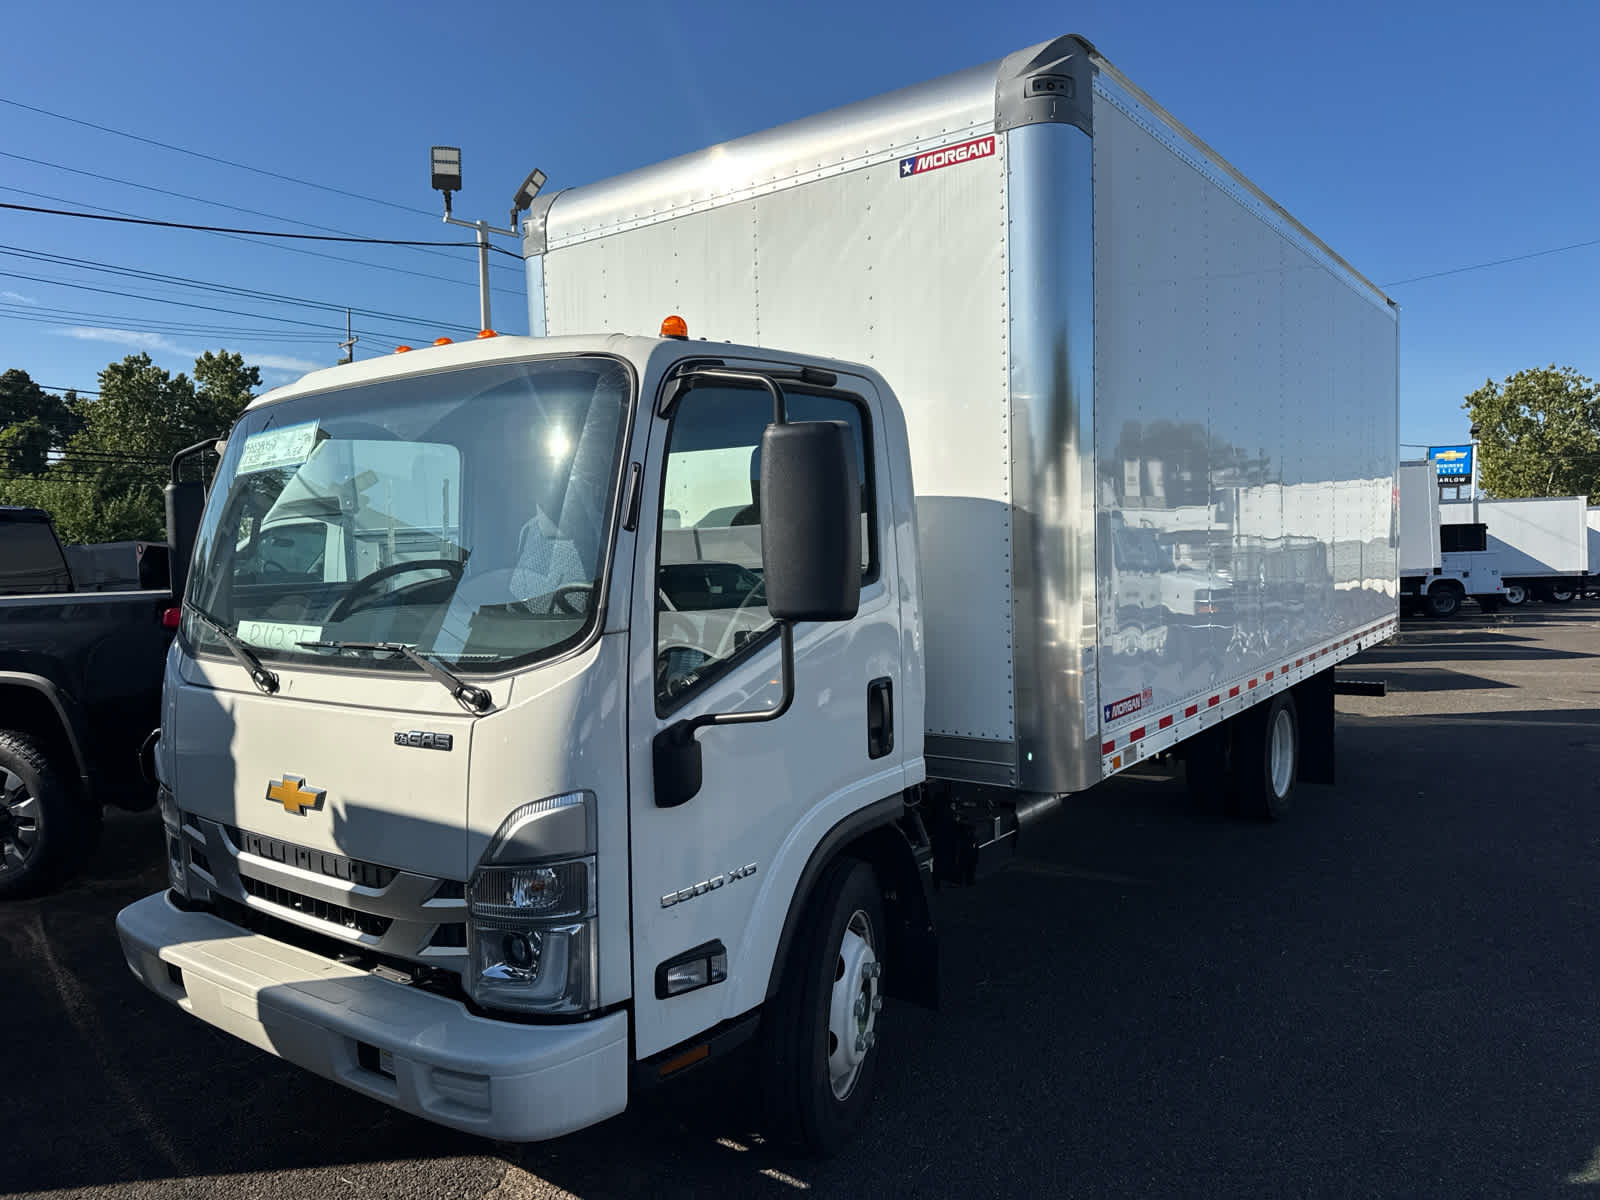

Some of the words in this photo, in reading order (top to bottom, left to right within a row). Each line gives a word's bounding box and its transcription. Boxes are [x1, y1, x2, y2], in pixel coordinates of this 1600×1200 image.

[916, 140, 993, 172] MORGAN
[1111, 695, 1141, 718] MORGAN
[408, 731, 450, 750] GAS
